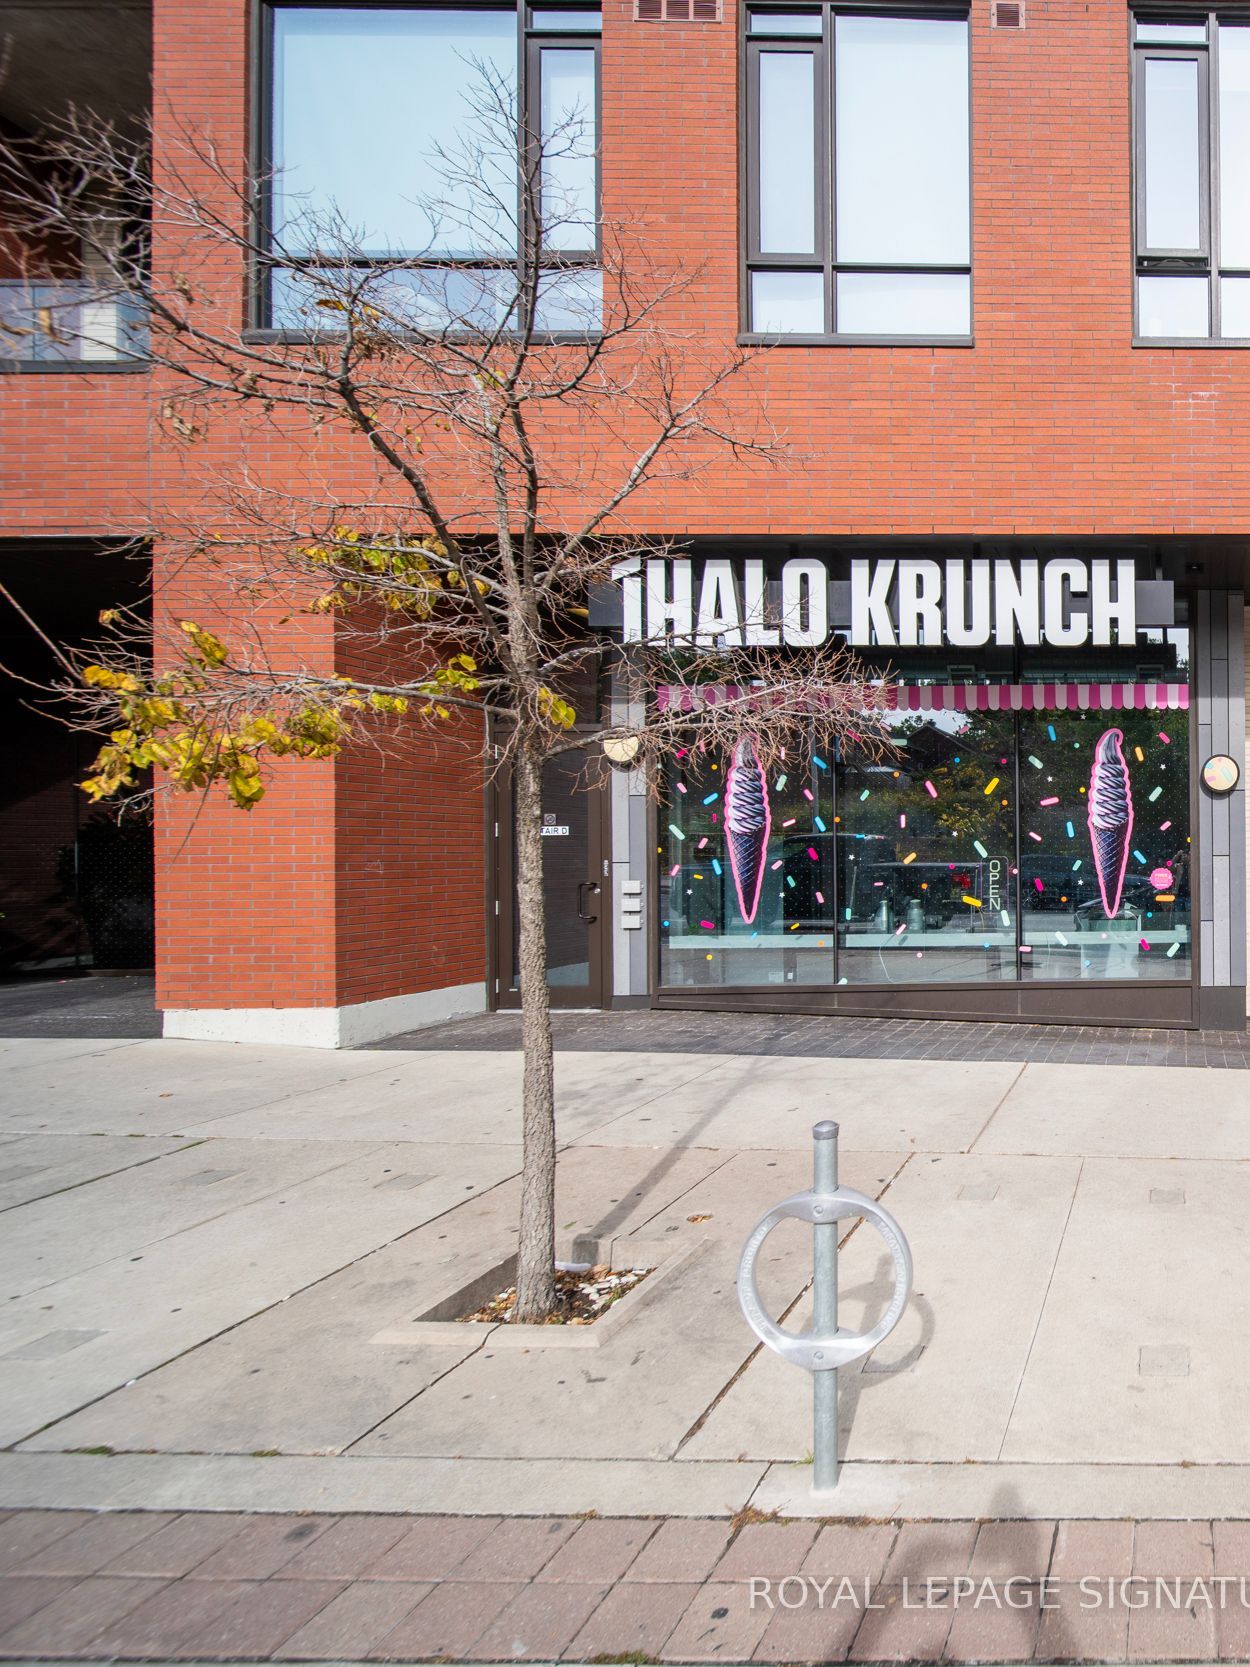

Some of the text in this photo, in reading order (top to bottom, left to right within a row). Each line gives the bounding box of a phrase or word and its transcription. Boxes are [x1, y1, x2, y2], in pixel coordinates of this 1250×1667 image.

[850, 558, 1137, 647] KRUNCH
[561, 827, 568, 835] D
[989, 859, 1001, 911] OPEN
